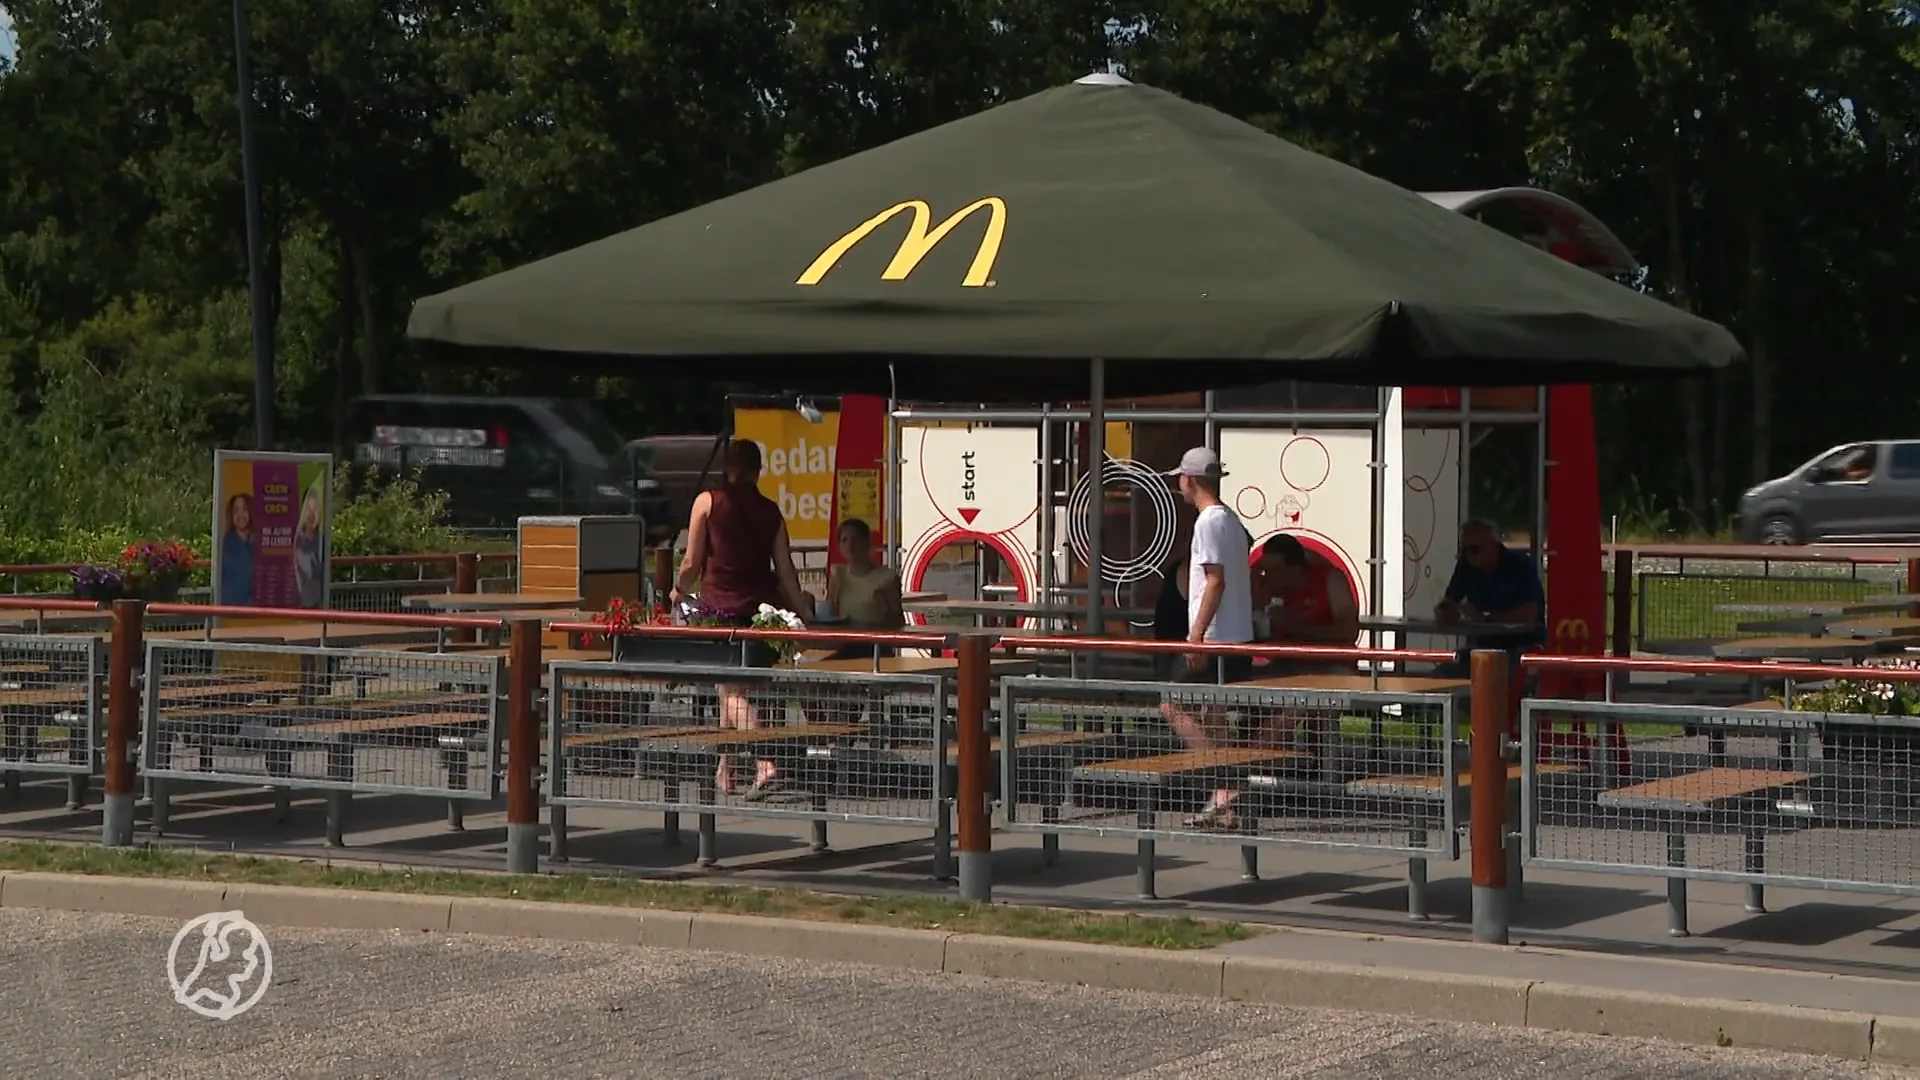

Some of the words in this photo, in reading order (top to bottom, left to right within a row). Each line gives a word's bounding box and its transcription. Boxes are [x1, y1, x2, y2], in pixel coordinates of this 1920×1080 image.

[961, 451, 975, 501] start
[264, 484, 288, 494] CREW
[264, 503, 288, 513] CREW
[778, 484, 832, 520] bes
